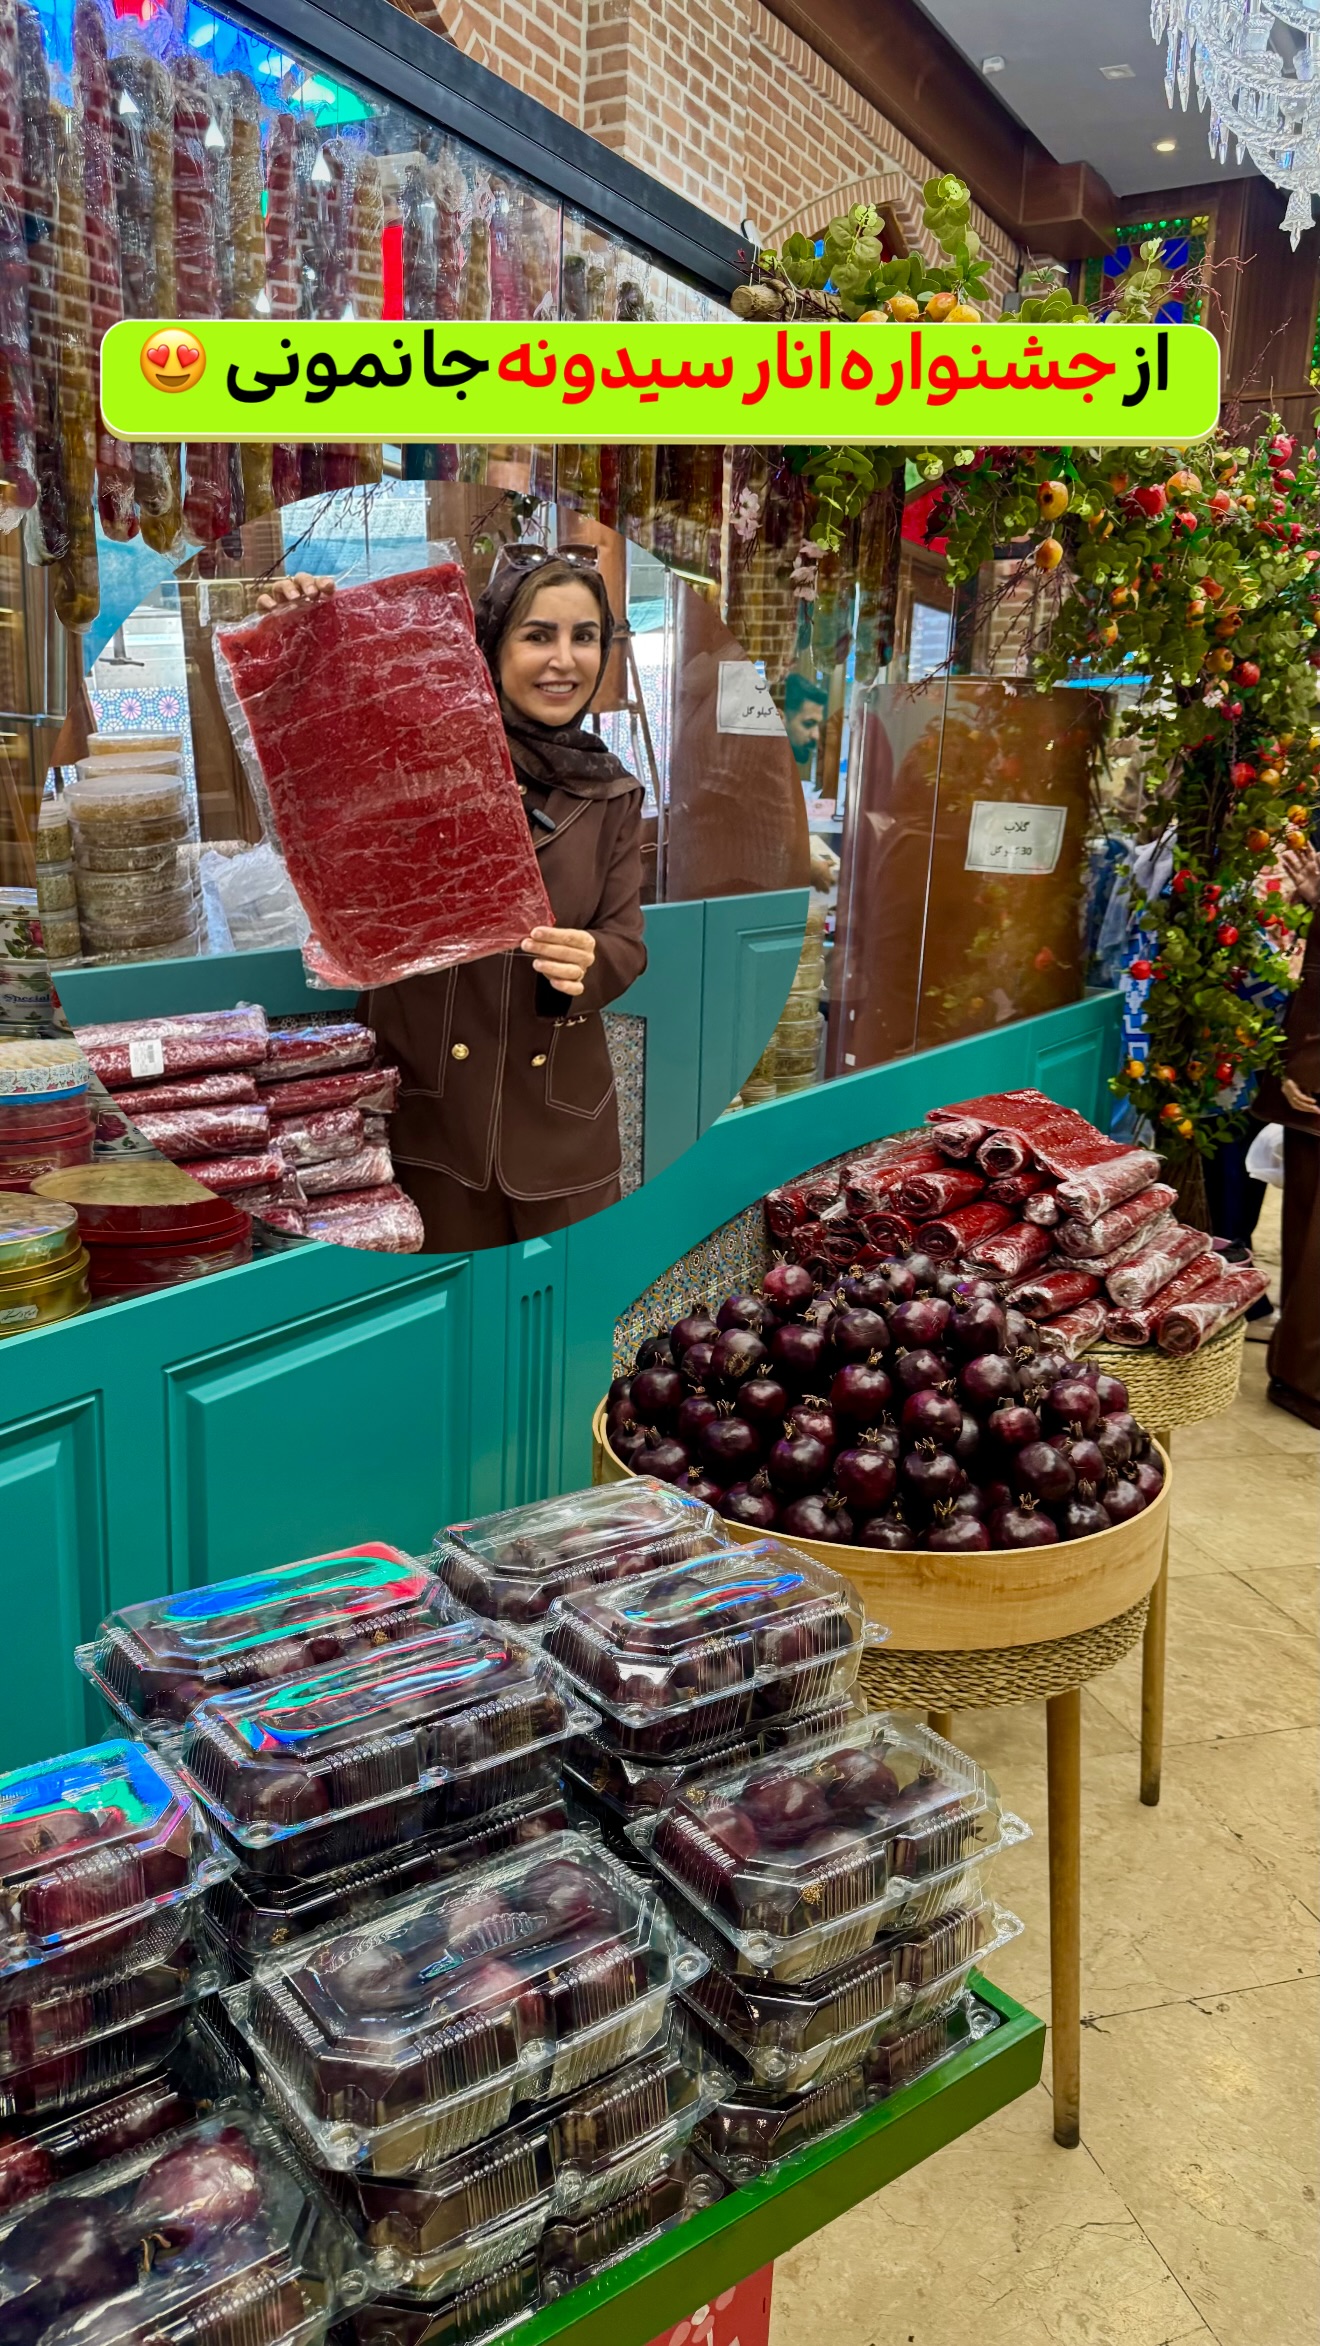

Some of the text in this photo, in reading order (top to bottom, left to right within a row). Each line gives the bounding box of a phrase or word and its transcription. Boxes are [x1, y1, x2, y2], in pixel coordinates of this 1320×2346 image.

[742, 706, 754, 717] گل
[1004, 822, 1030, 833] گلاب
[1021, 847, 1032, 855] 30
[3, 993, 50, 1003] Special
